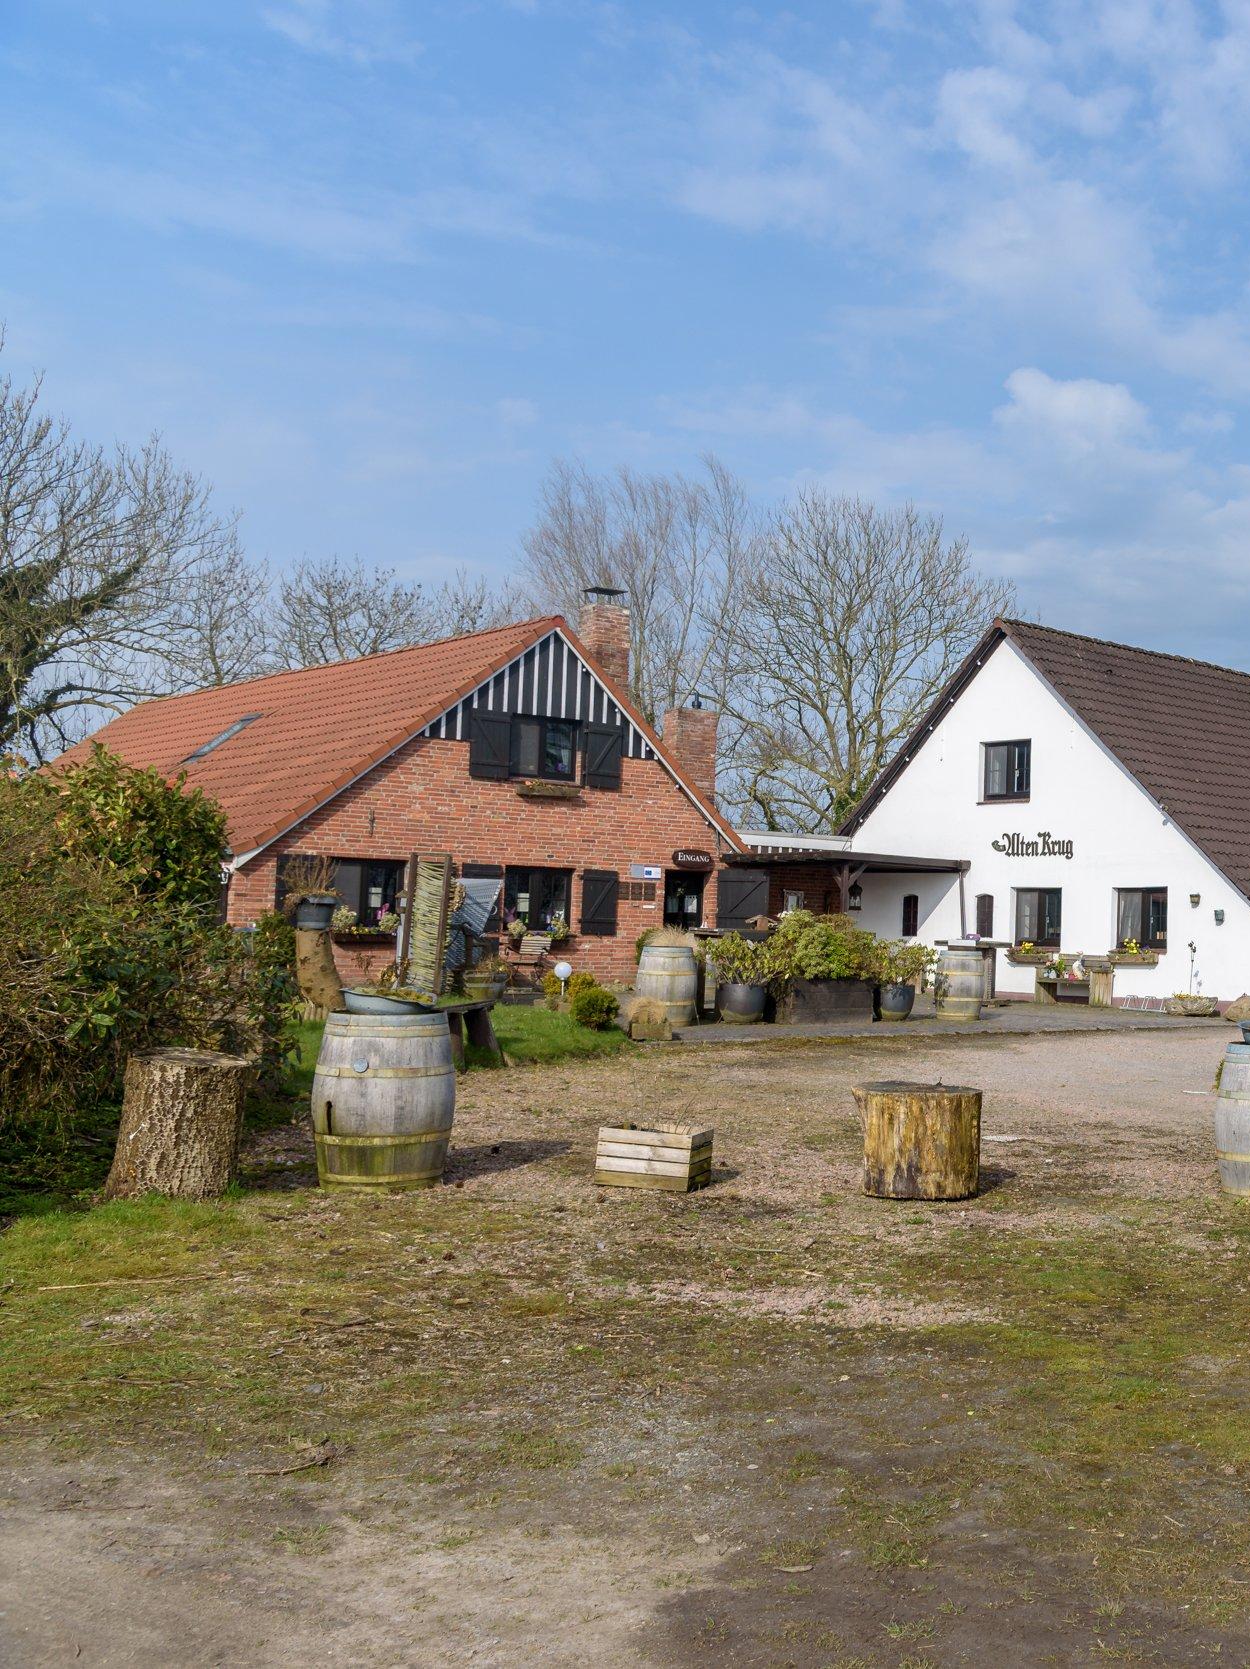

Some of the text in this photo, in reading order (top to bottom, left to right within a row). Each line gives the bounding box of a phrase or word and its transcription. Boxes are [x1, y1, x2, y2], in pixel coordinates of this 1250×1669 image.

[1002, 831, 1074, 860] Alten Krug
[678, 852, 710, 863] EINGANG
